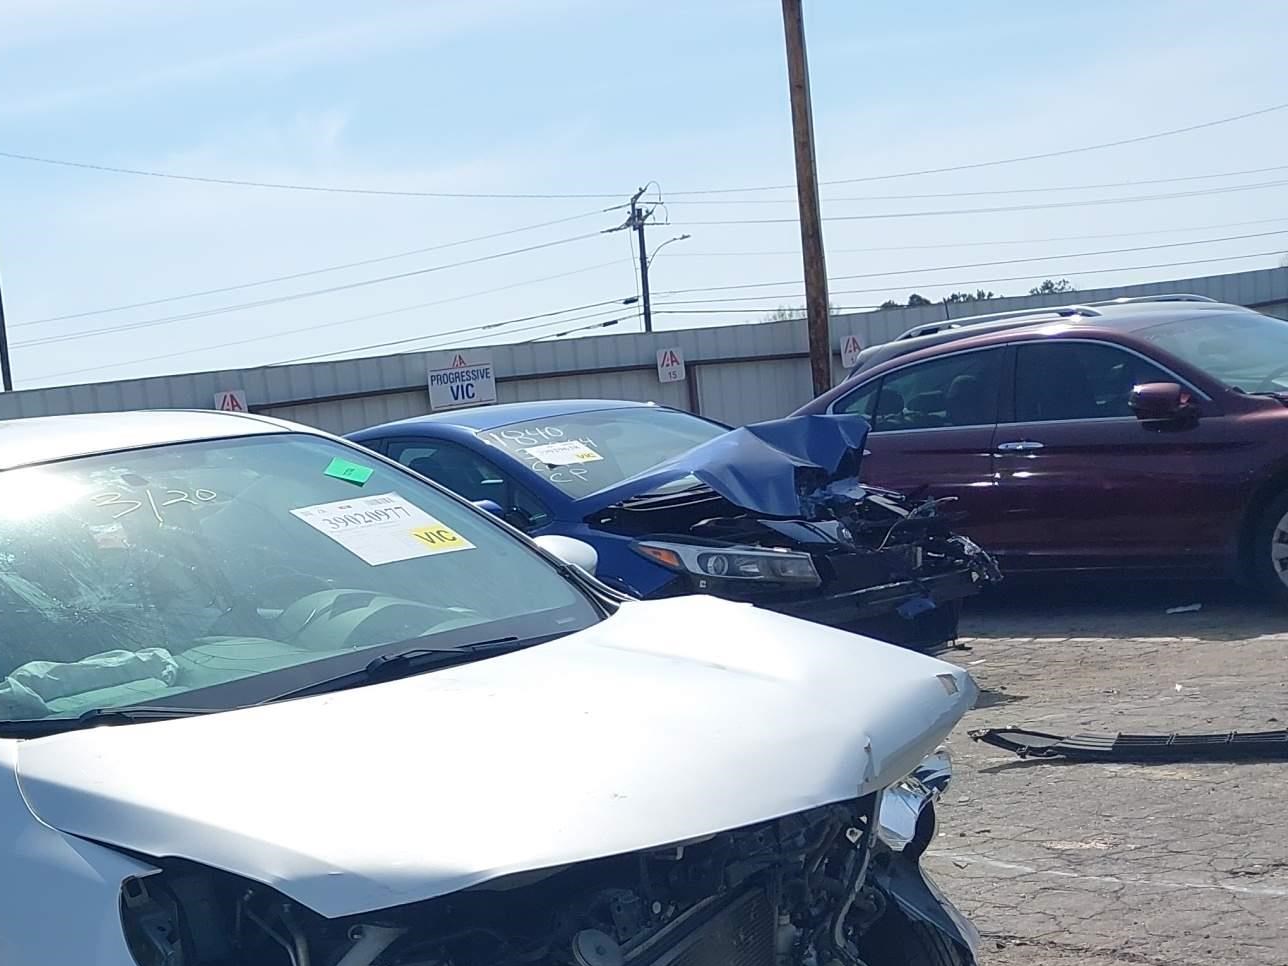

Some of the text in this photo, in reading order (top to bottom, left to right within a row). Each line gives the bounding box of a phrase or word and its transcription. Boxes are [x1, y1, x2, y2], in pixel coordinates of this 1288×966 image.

[430, 367, 491, 387] PROGRESSIVE
[668, 371, 678, 380] 15
[450, 383, 476, 401] VIC
[322, 506, 411, 530] 39020977
[414, 529, 458, 544] VIC
